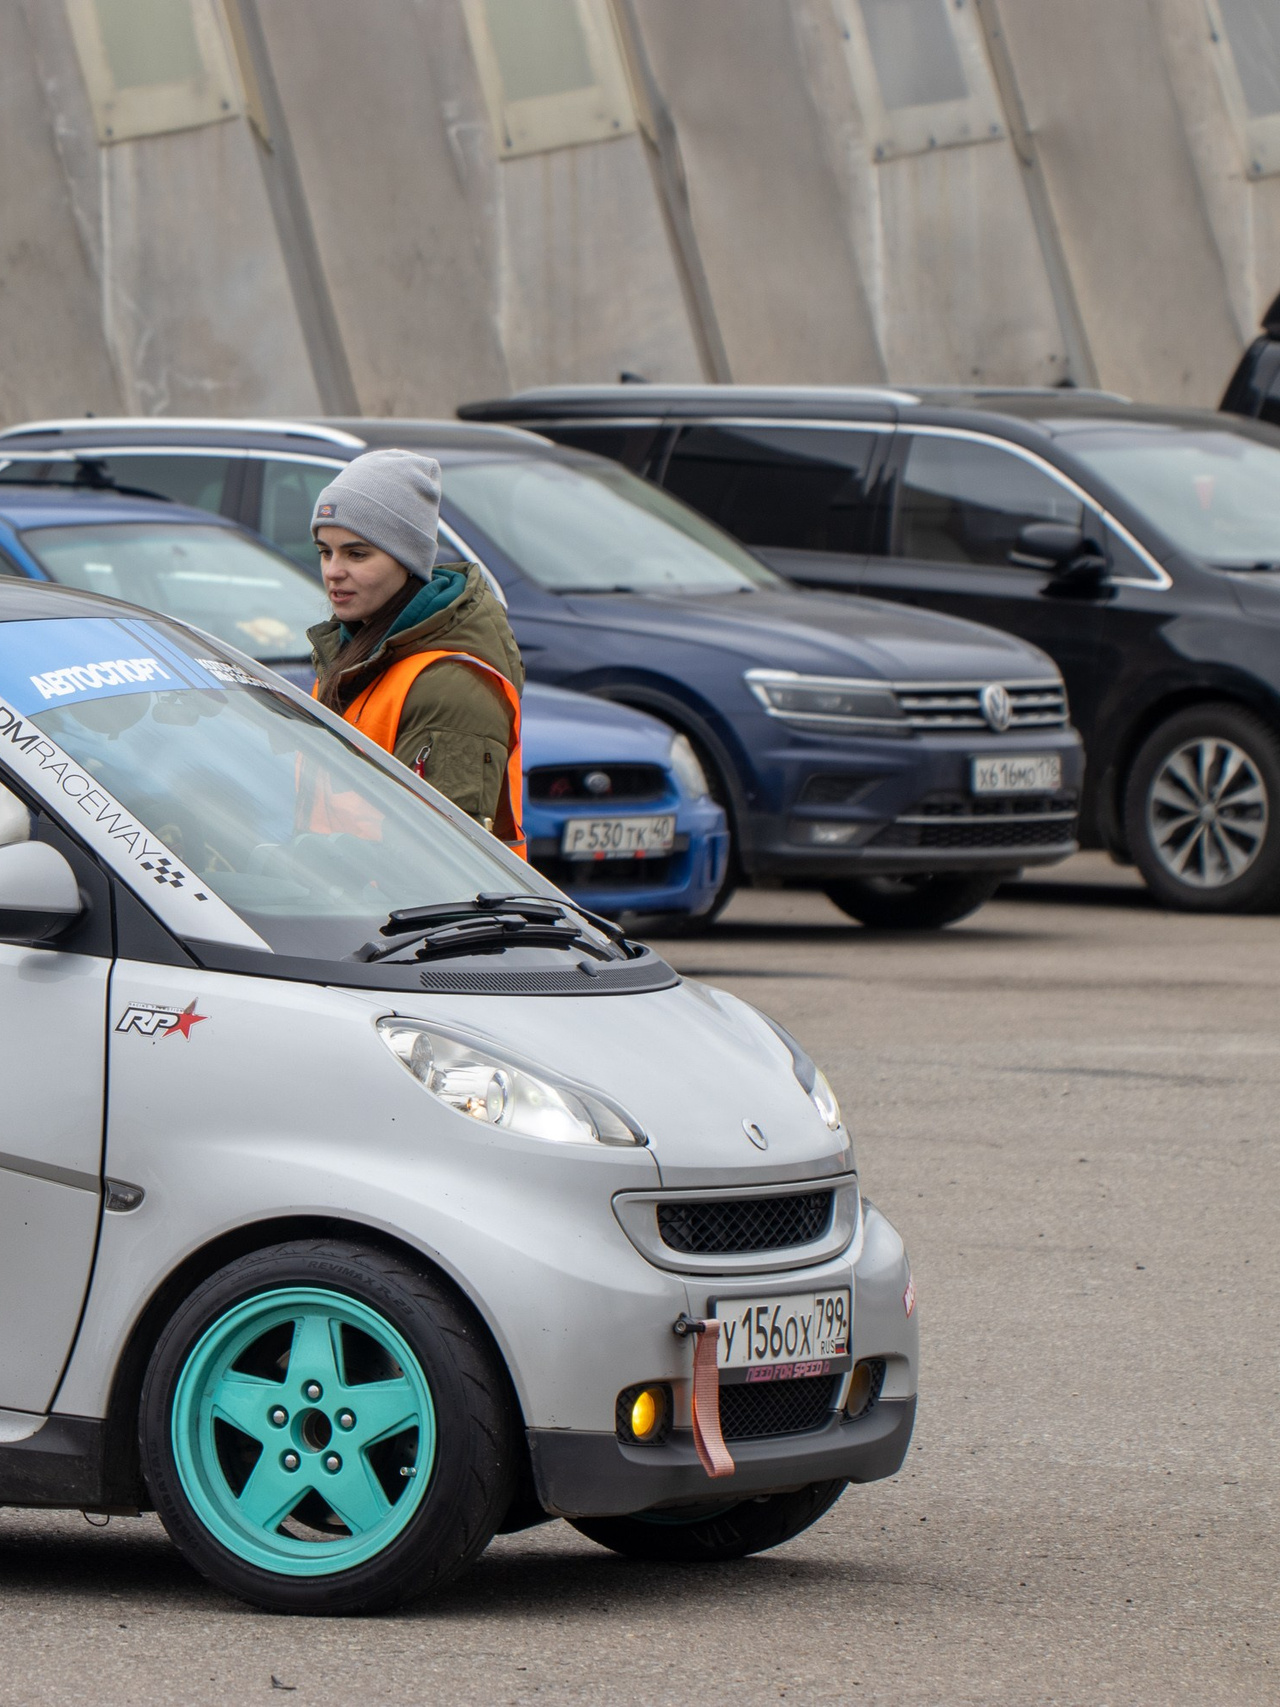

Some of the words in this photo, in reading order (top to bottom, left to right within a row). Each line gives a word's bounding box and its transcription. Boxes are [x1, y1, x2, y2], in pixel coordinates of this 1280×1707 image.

[29, 658, 171, 699] АВТОСПОРТ
[307, 1260, 376, 1288] REVIMAX
[816, 1296, 844, 1339] 799
[820, 1339, 835, 1355] RUS
[793, 1361, 823, 1379] SPEED
